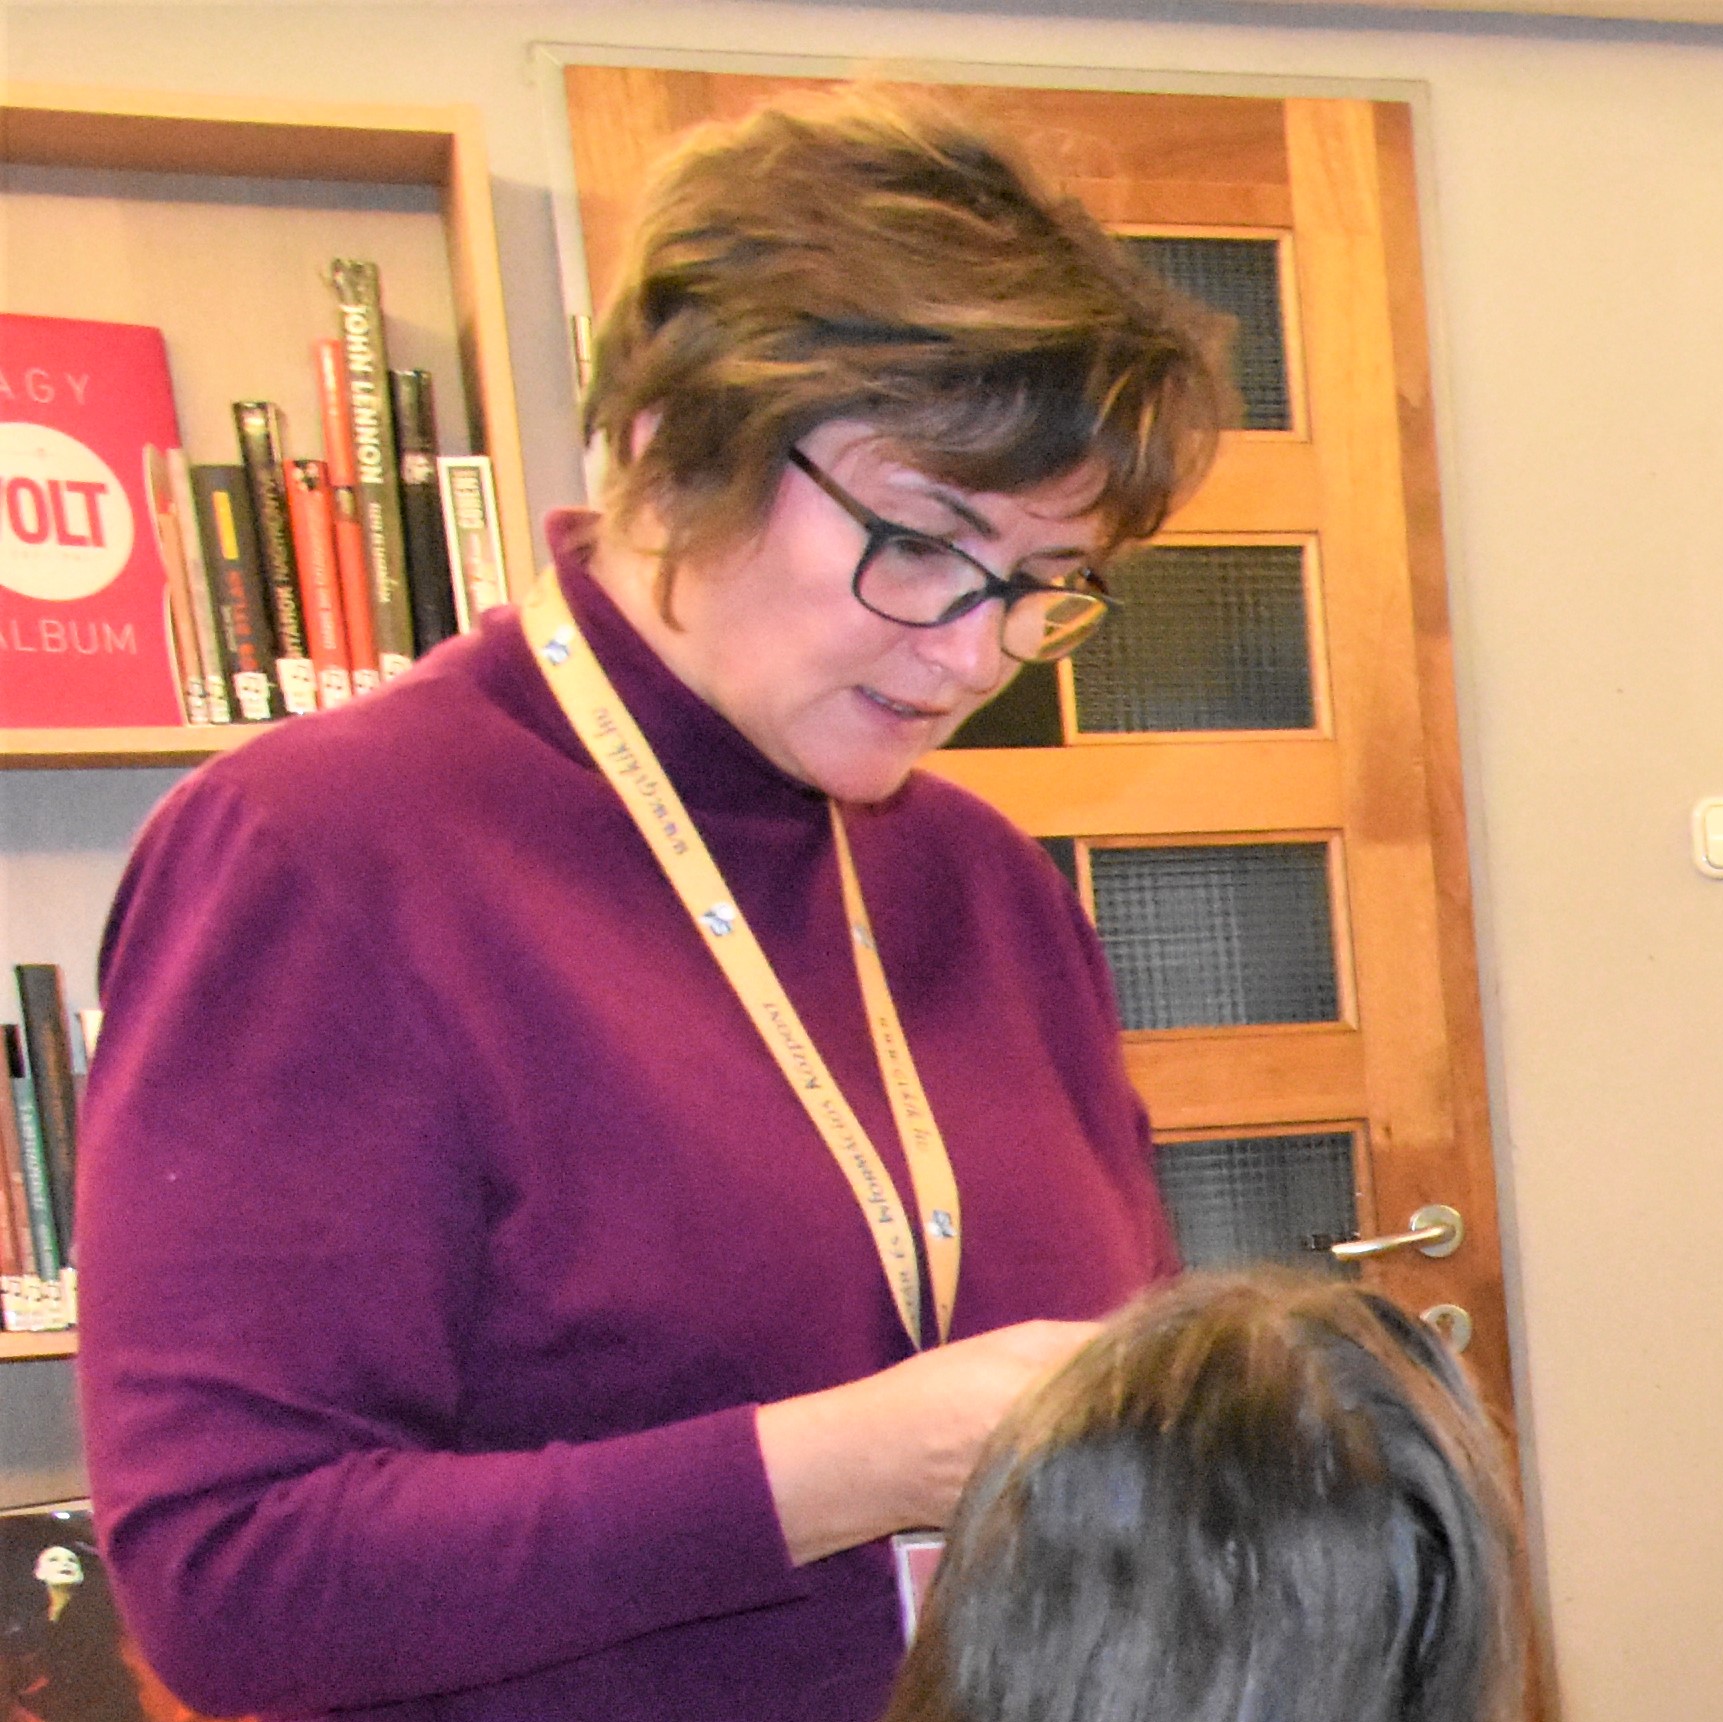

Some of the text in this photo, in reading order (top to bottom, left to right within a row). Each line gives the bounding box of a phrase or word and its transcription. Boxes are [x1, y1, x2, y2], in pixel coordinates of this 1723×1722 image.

[344, 302, 383, 486] JOHN LENNON
[0, 475, 110, 548] OLT
[0, 619, 138, 655] LBUM
